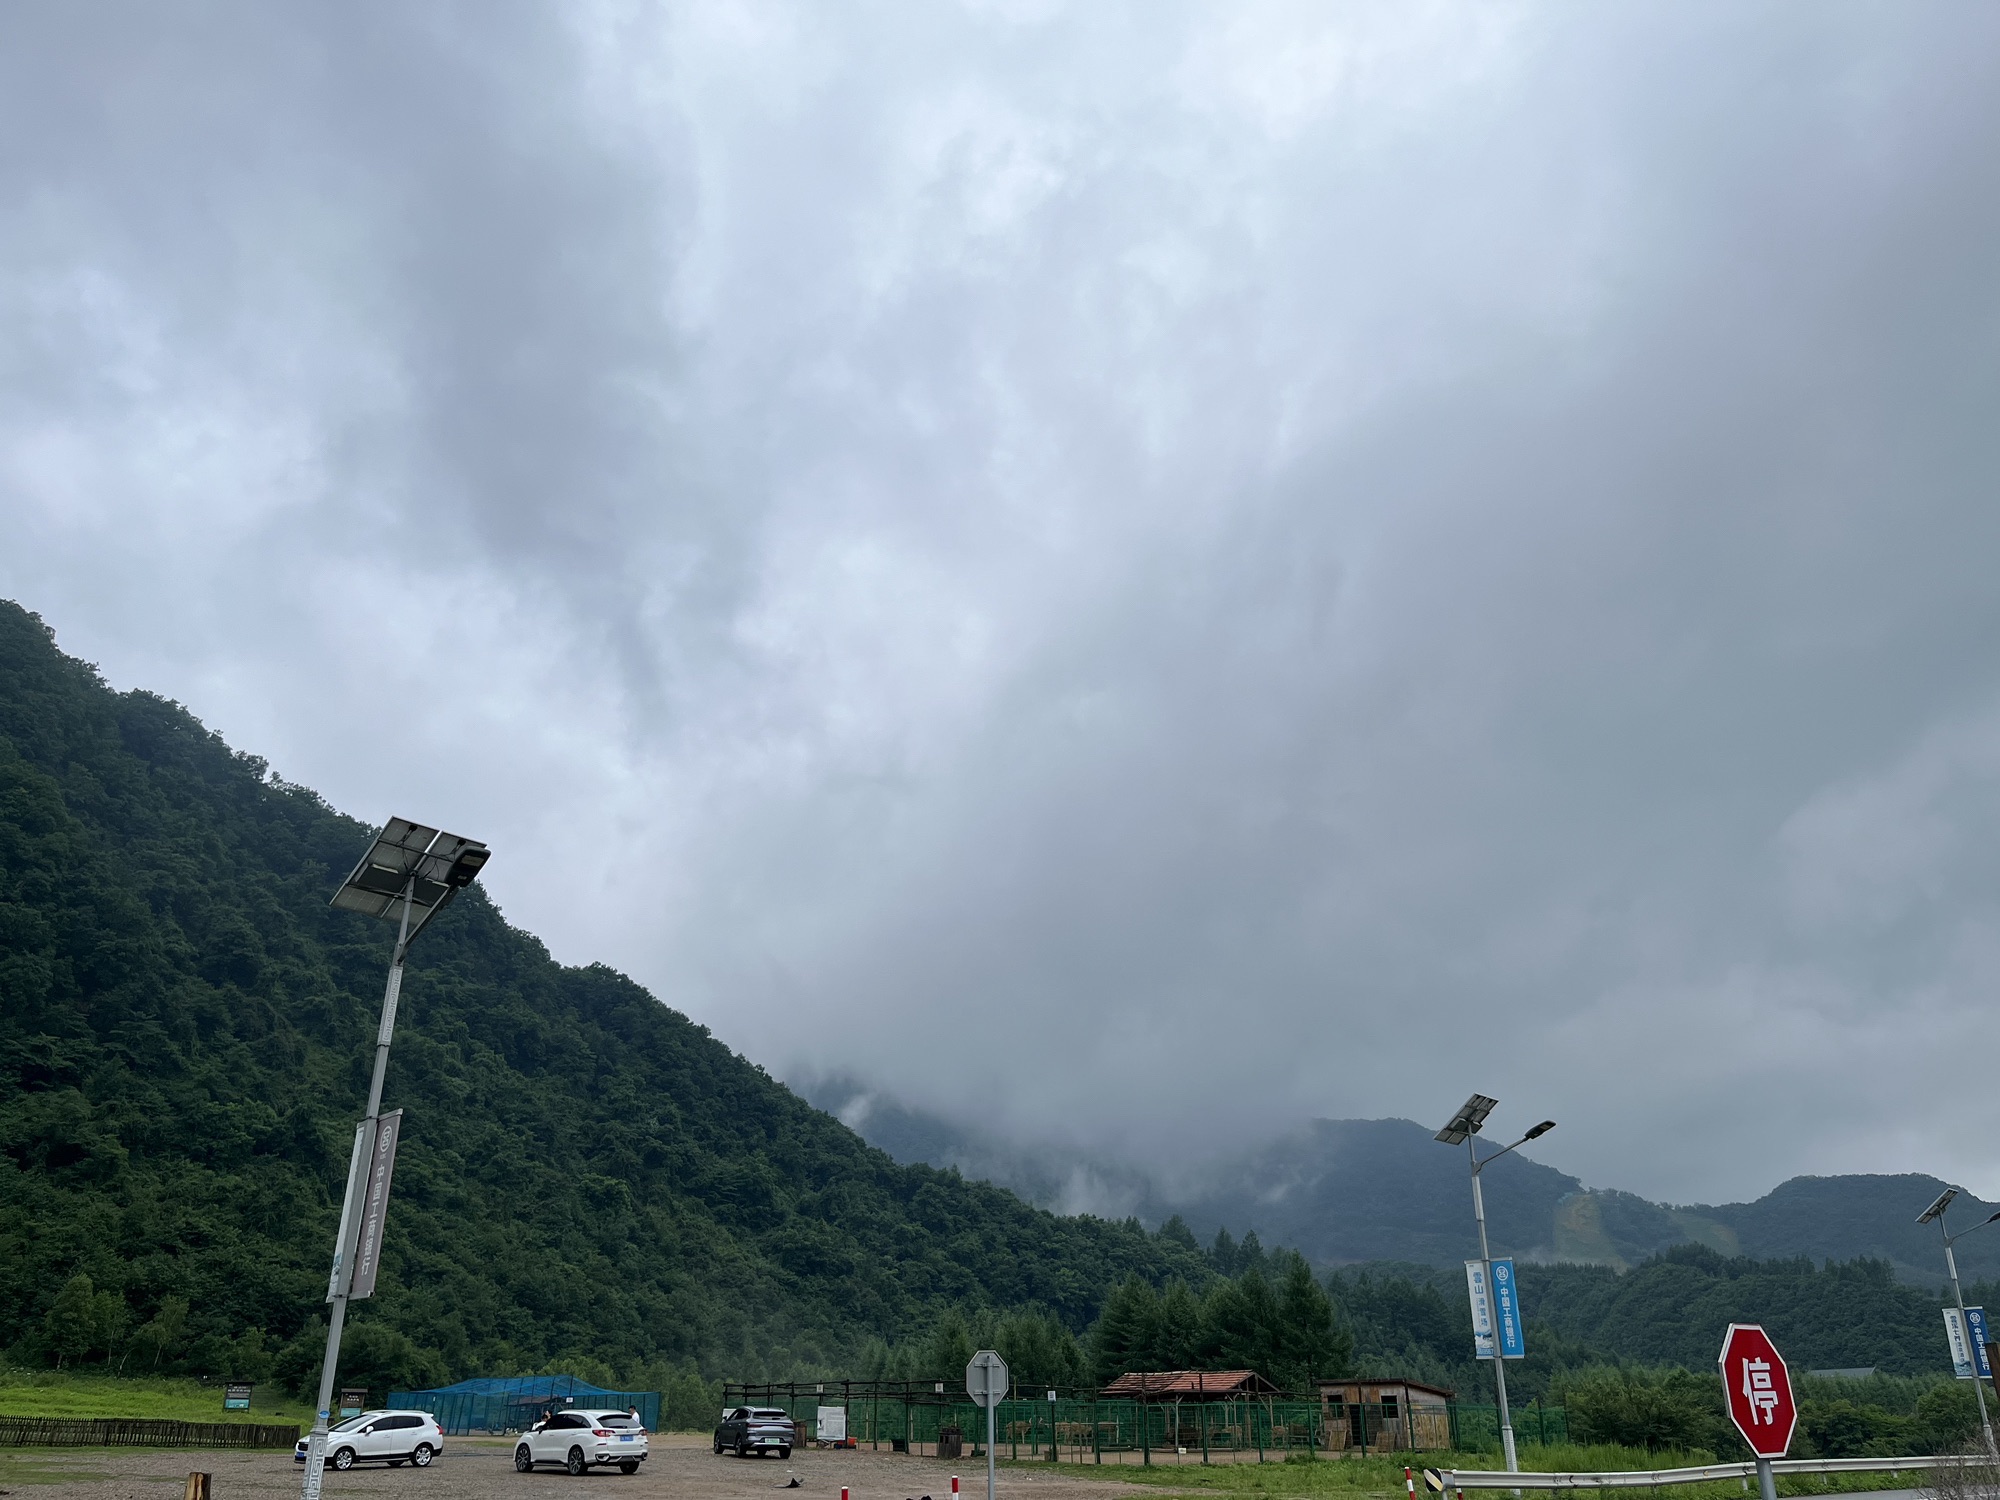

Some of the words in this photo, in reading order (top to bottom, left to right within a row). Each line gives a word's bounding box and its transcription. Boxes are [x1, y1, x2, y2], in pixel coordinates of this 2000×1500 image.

[361, 1163, 385, 1276] 中国工商银行
[1500, 1287, 1515, 1348] 中国工商银行
[1974, 1327, 1990, 1371] 中国工商银行
[1742, 1357, 1779, 1426] 停
